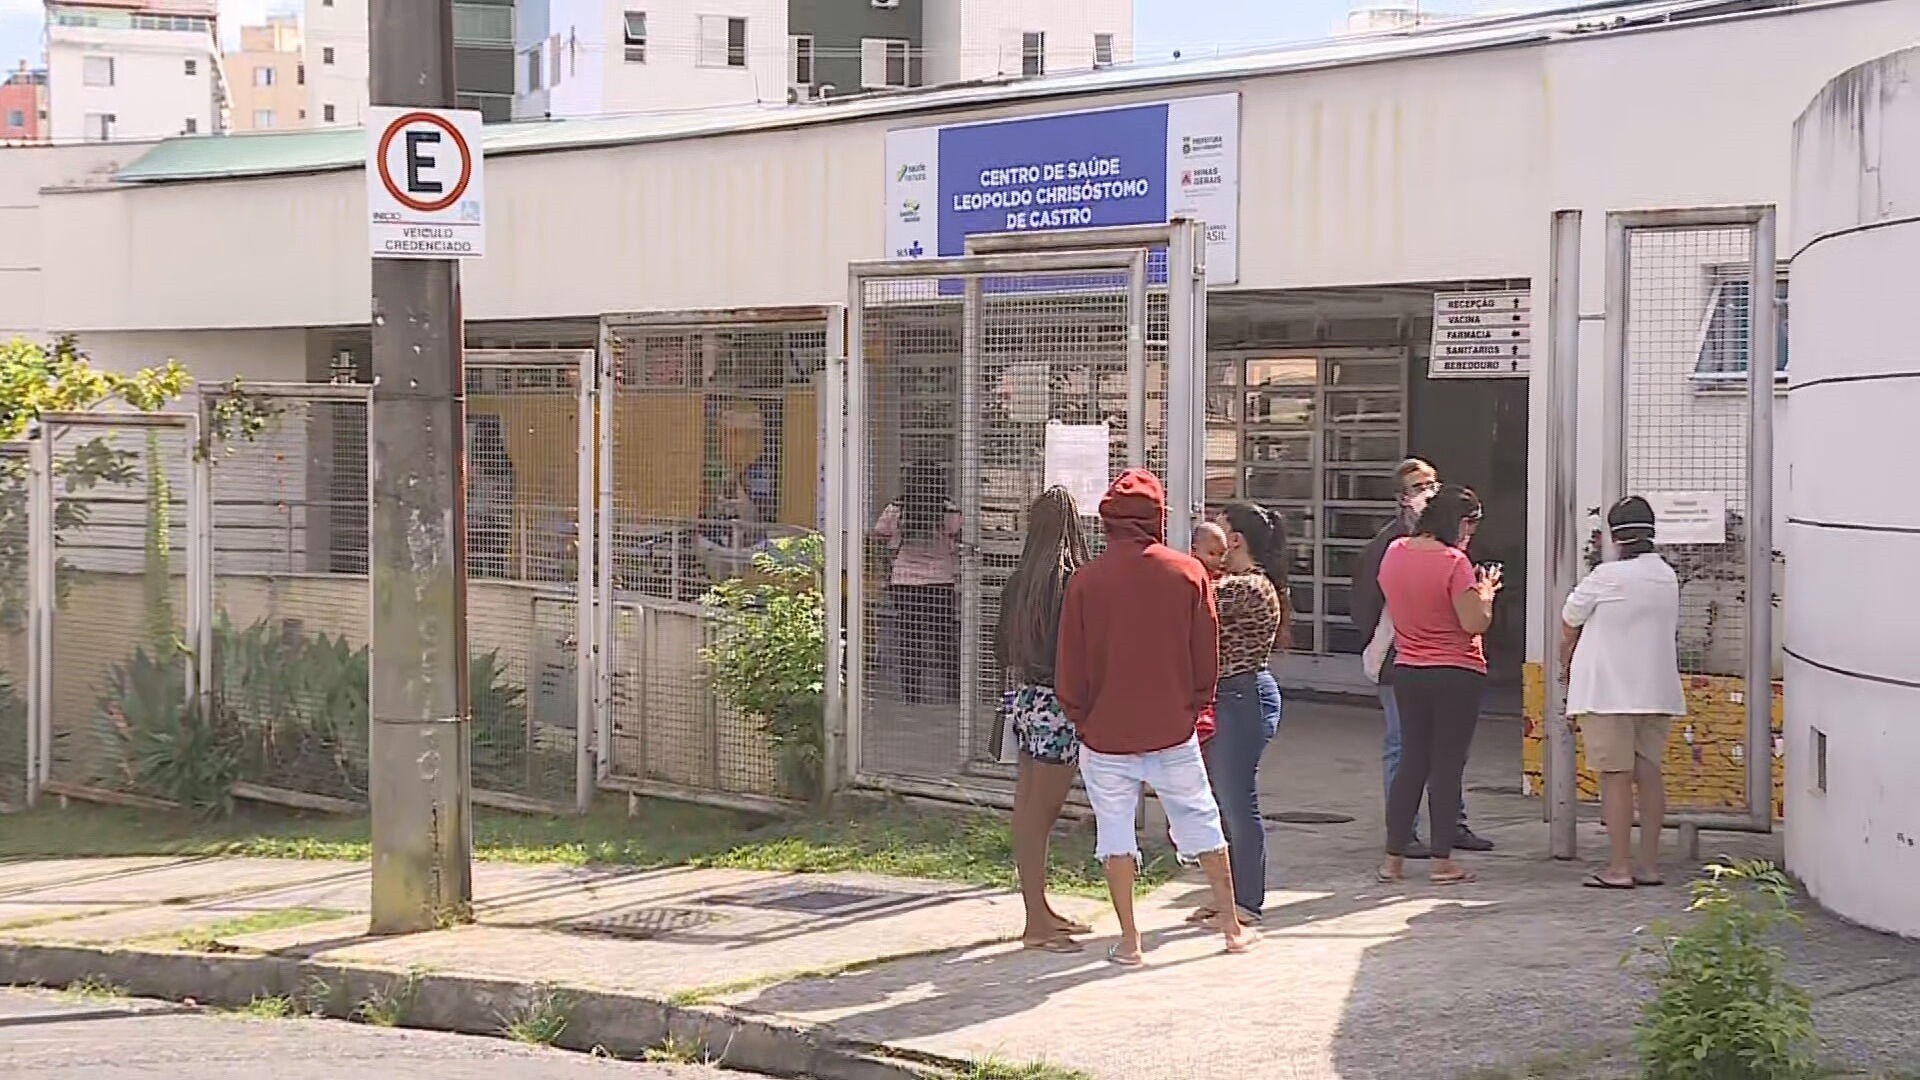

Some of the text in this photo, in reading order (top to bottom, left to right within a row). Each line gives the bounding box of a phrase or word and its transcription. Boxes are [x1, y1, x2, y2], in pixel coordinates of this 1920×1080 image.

[406, 131, 442, 193] E
[980, 156, 1120, 186] CENTRO DE SAÚDE
[1193, 168, 1218, 176] MINAS
[954, 179, 1149, 211] LEOPOLDO CHRISÓSTOMO
[1006, 207, 1092, 229] DE CASTRO
[385, 240, 471, 251] CREDENCIADO
[1206, 231, 1225, 240] ASIL
